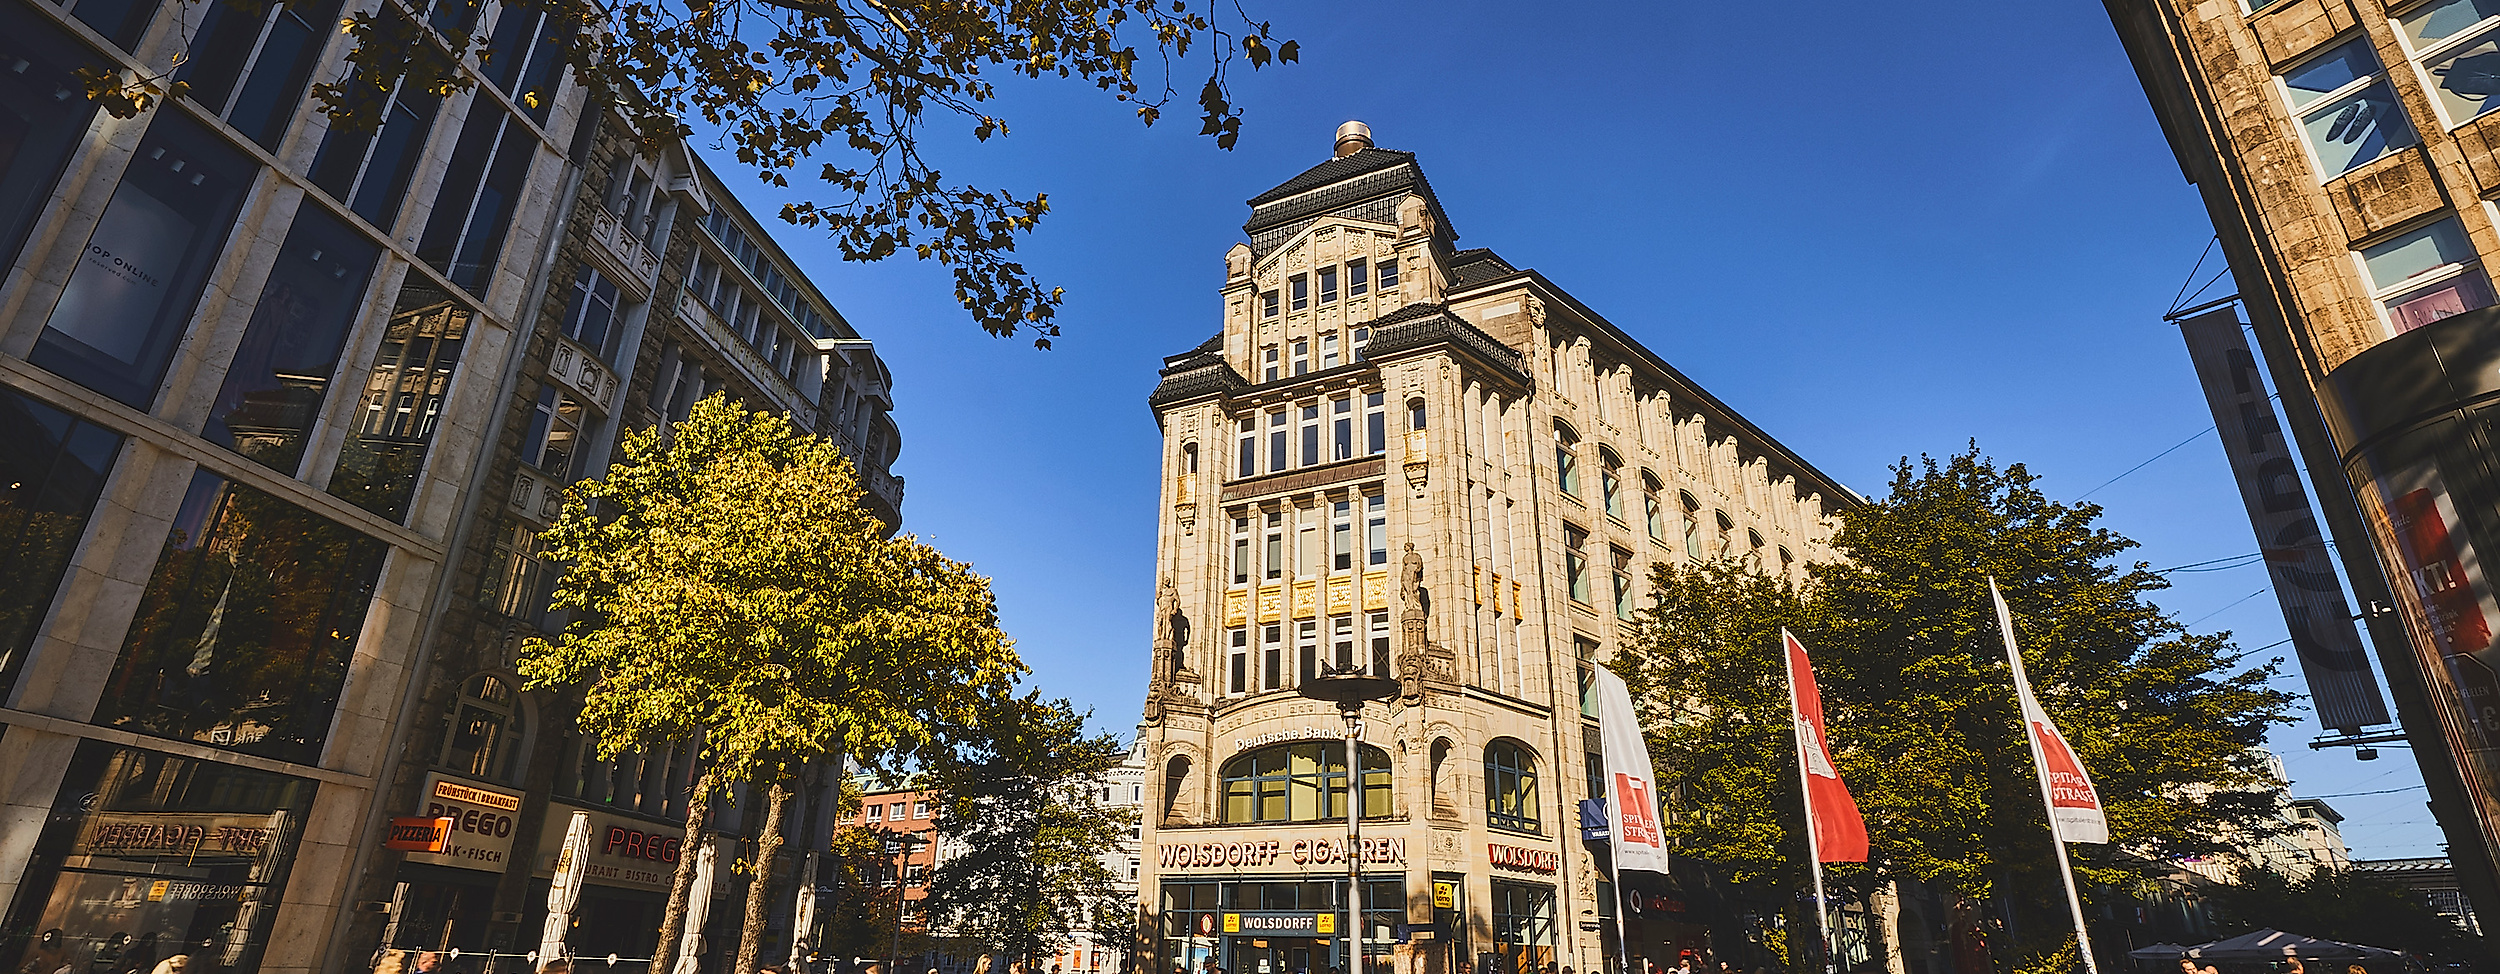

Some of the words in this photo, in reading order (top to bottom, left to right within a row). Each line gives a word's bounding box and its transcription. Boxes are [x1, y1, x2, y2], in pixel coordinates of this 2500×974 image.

[113, 257, 160, 288] ONLINE
[1234, 728, 1300, 752] Deutsche
[1302, 725, 1341, 740] Bank
[427, 801, 513, 838] PREGO
[390, 824, 442, 843] PIZZERIA
[603, 824, 684, 864] PREG
[467, 847, 503, 864] FISCH
[1157, 839, 1280, 868] WOLSDORFF
[1290, 836, 1409, 866] CIGAREN
[1490, 844, 1560, 871] WOLSDORFF
[625, 869, 660, 884] BISTRO
[1243, 916, 1314, 930] WOLSDORFF
